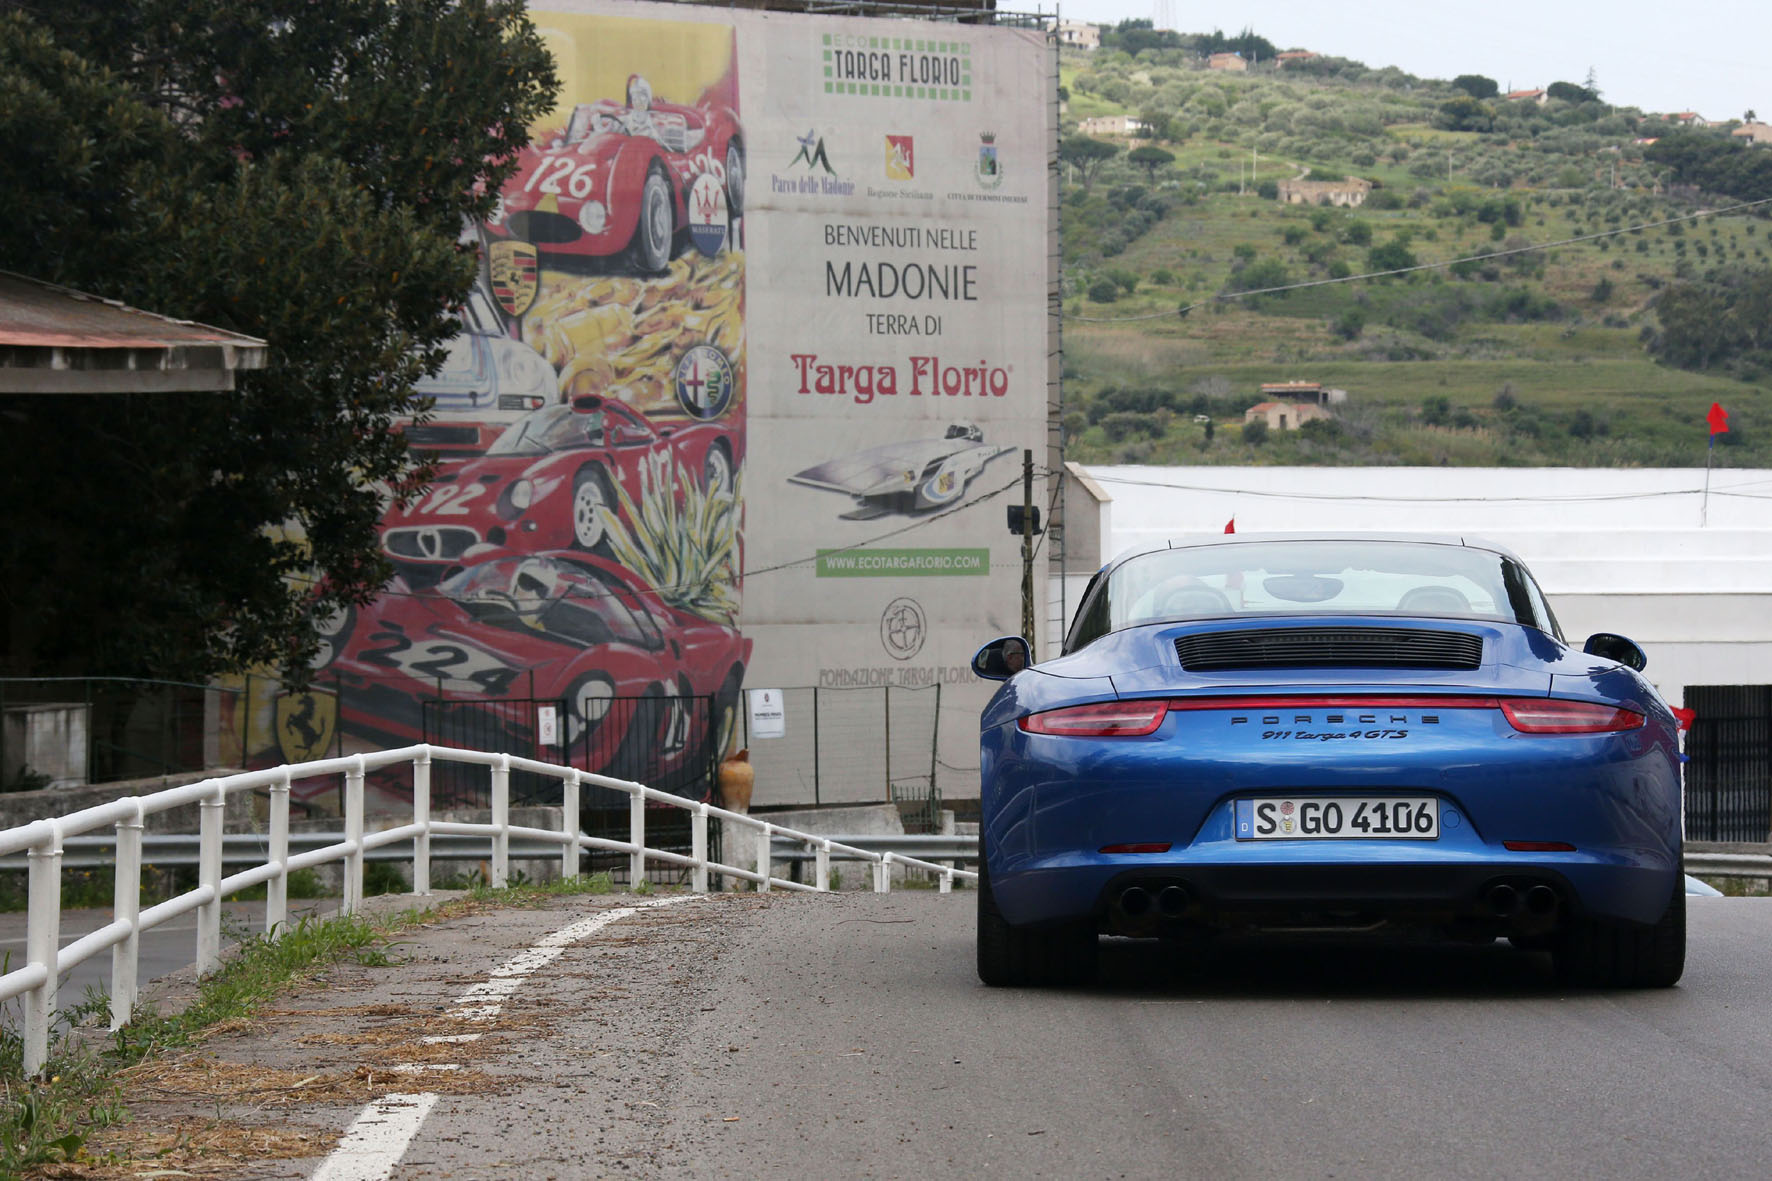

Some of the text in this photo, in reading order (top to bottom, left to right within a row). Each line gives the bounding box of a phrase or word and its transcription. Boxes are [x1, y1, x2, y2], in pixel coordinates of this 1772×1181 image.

[833, 33, 867, 48] ECO
[834, 50, 960, 86] TARGA FLORIO
[524, 156, 596, 199] 126
[824, 224, 977, 250] BENVENUTI NELLE
[826, 260, 978, 301] MADONIE
[866, 313, 942, 335] TERRA DI
[790, 354, 1009, 404] Targa Florio
[825, 556, 981, 570] WWW.ECOTARGAFLORIO.COM
[356, 631, 521, 696] 224
[819, 667, 894, 686] FONDAZIONE
[897, 666, 934, 686] TARGA
[1231, 714, 1440, 726] PORSCHE
[1261, 730, 1291, 740] 911
[1364, 729, 1409, 740] GTS
[1256, 802, 1277, 835] S
[1351, 802, 1434, 834] 4106
